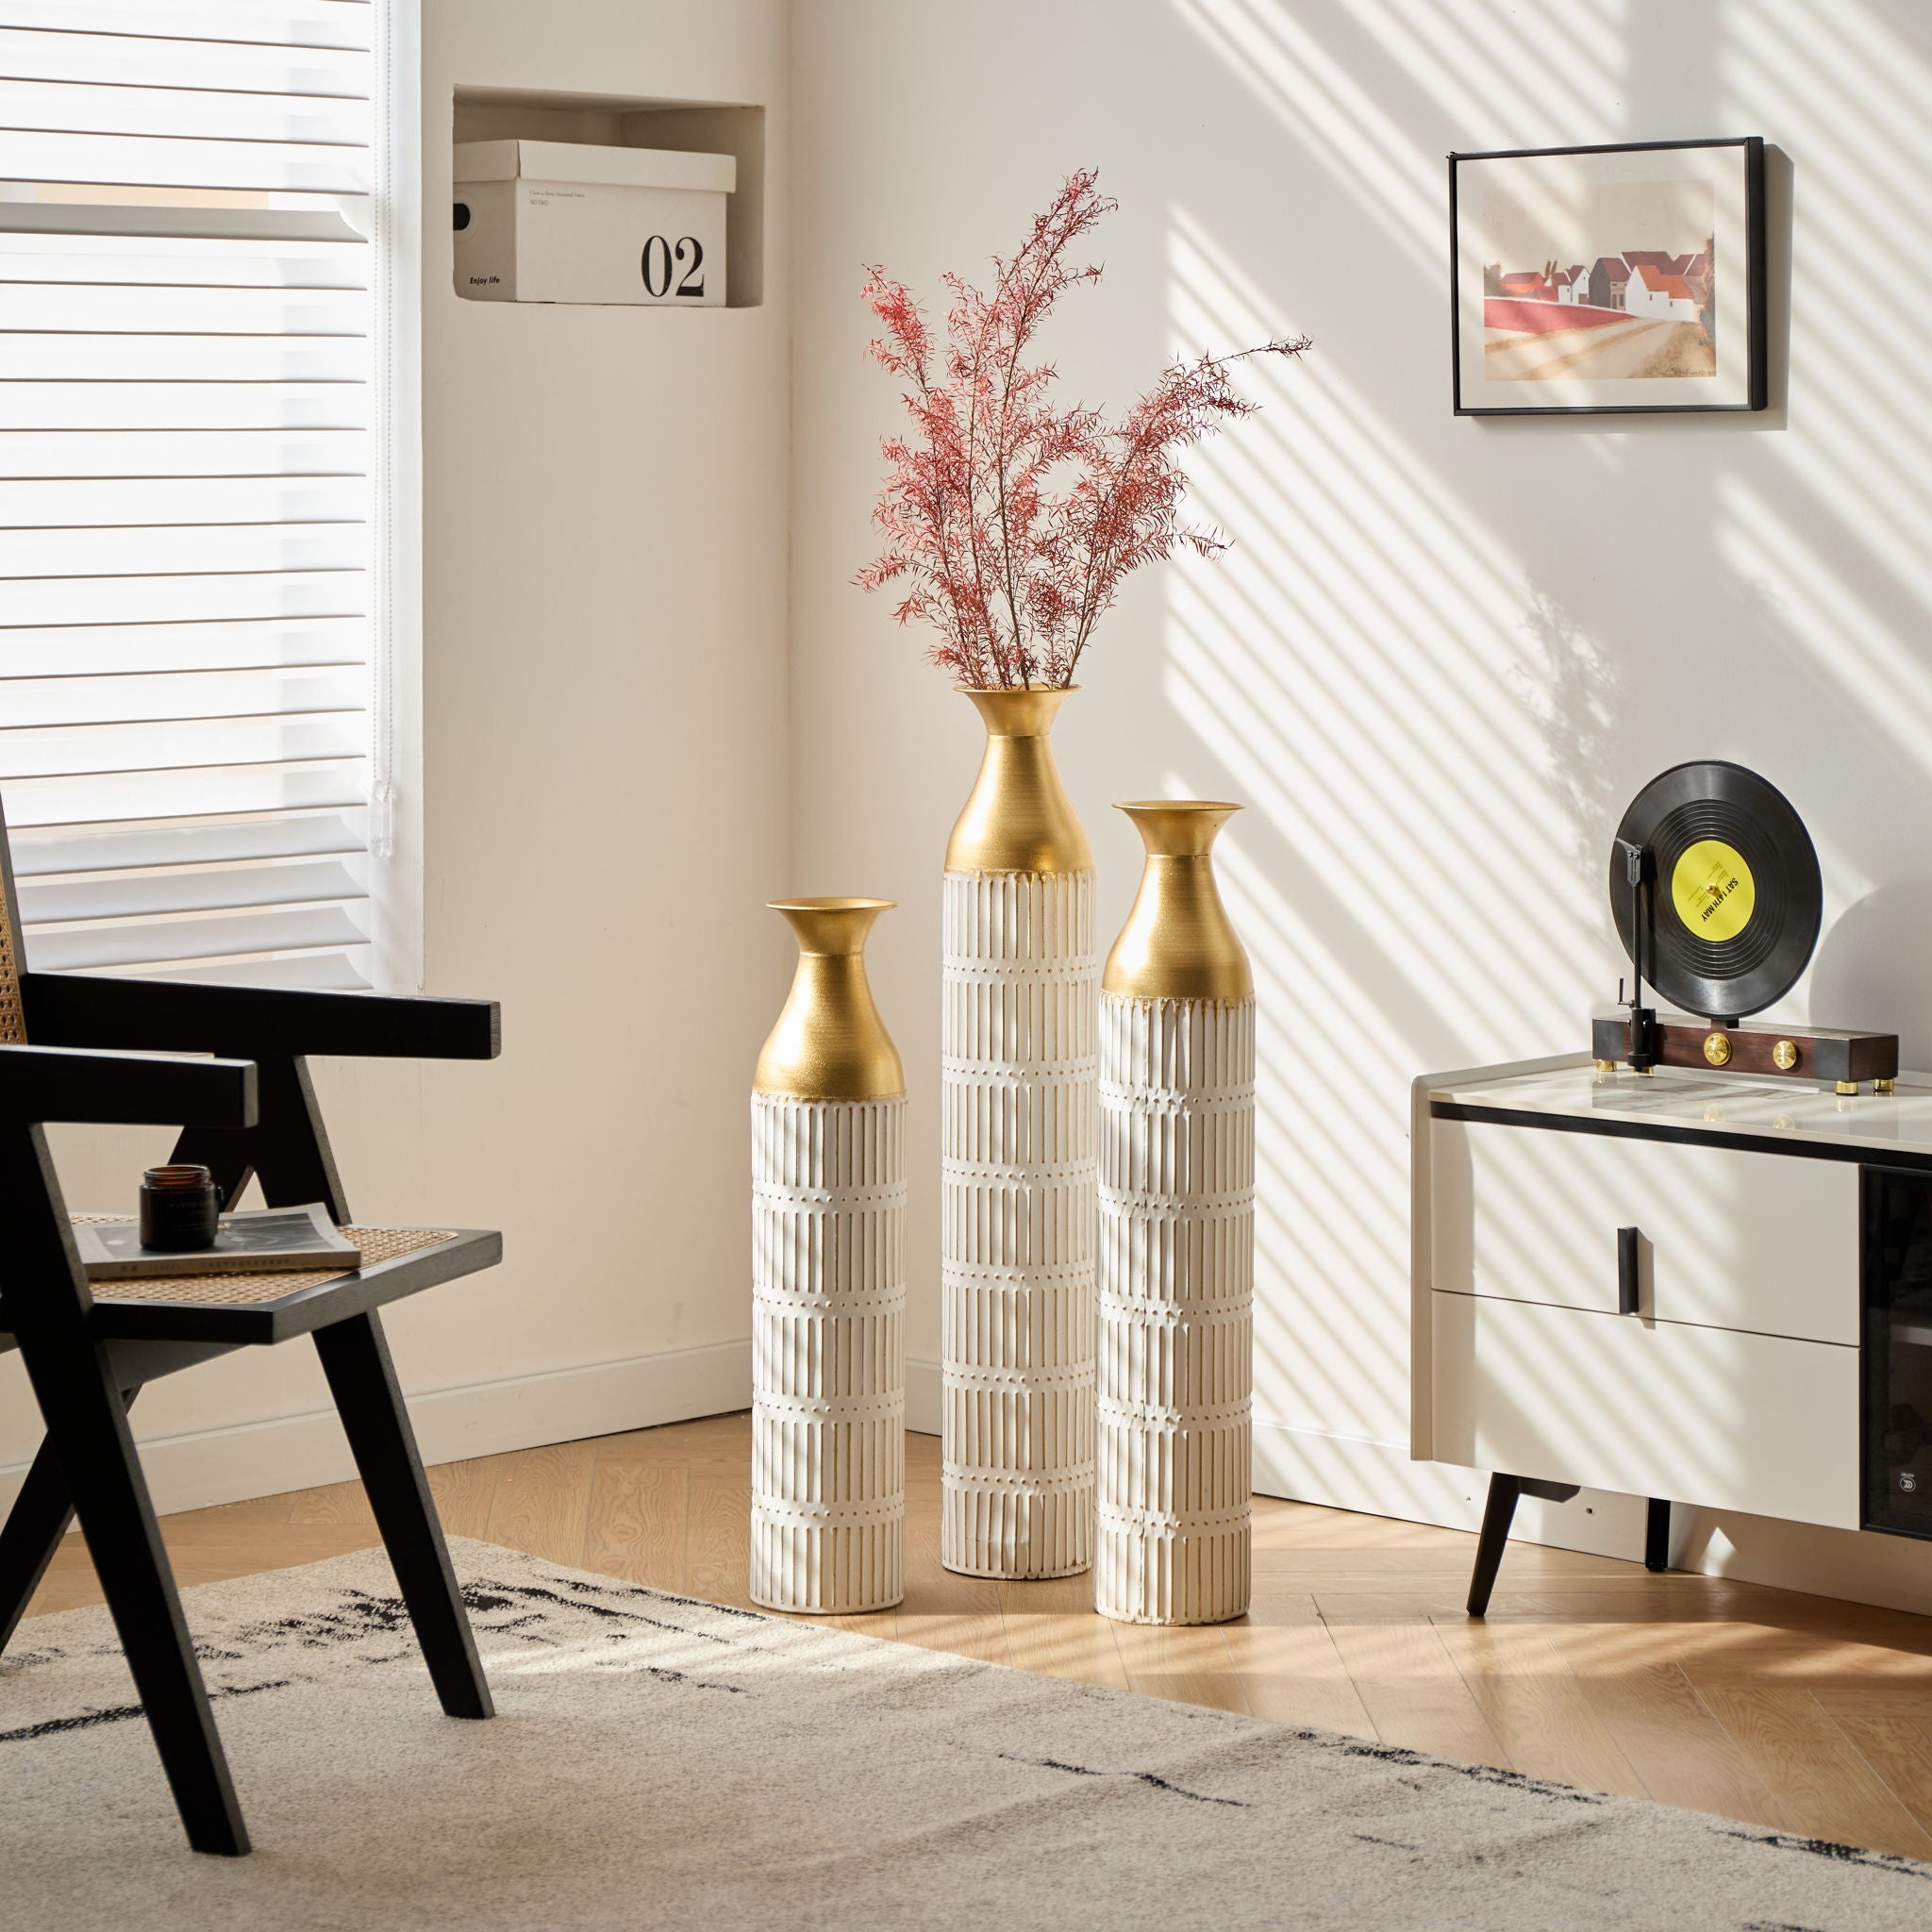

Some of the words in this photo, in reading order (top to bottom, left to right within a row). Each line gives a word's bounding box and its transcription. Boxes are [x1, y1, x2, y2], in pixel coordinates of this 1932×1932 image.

[641, 235, 704, 297] 02
[469, 276, 487, 286] Enjoy
[489, 275, 500, 284] life
[1725, 877, 1739, 893] SAT
[1701, 905, 1715, 922] MAY
